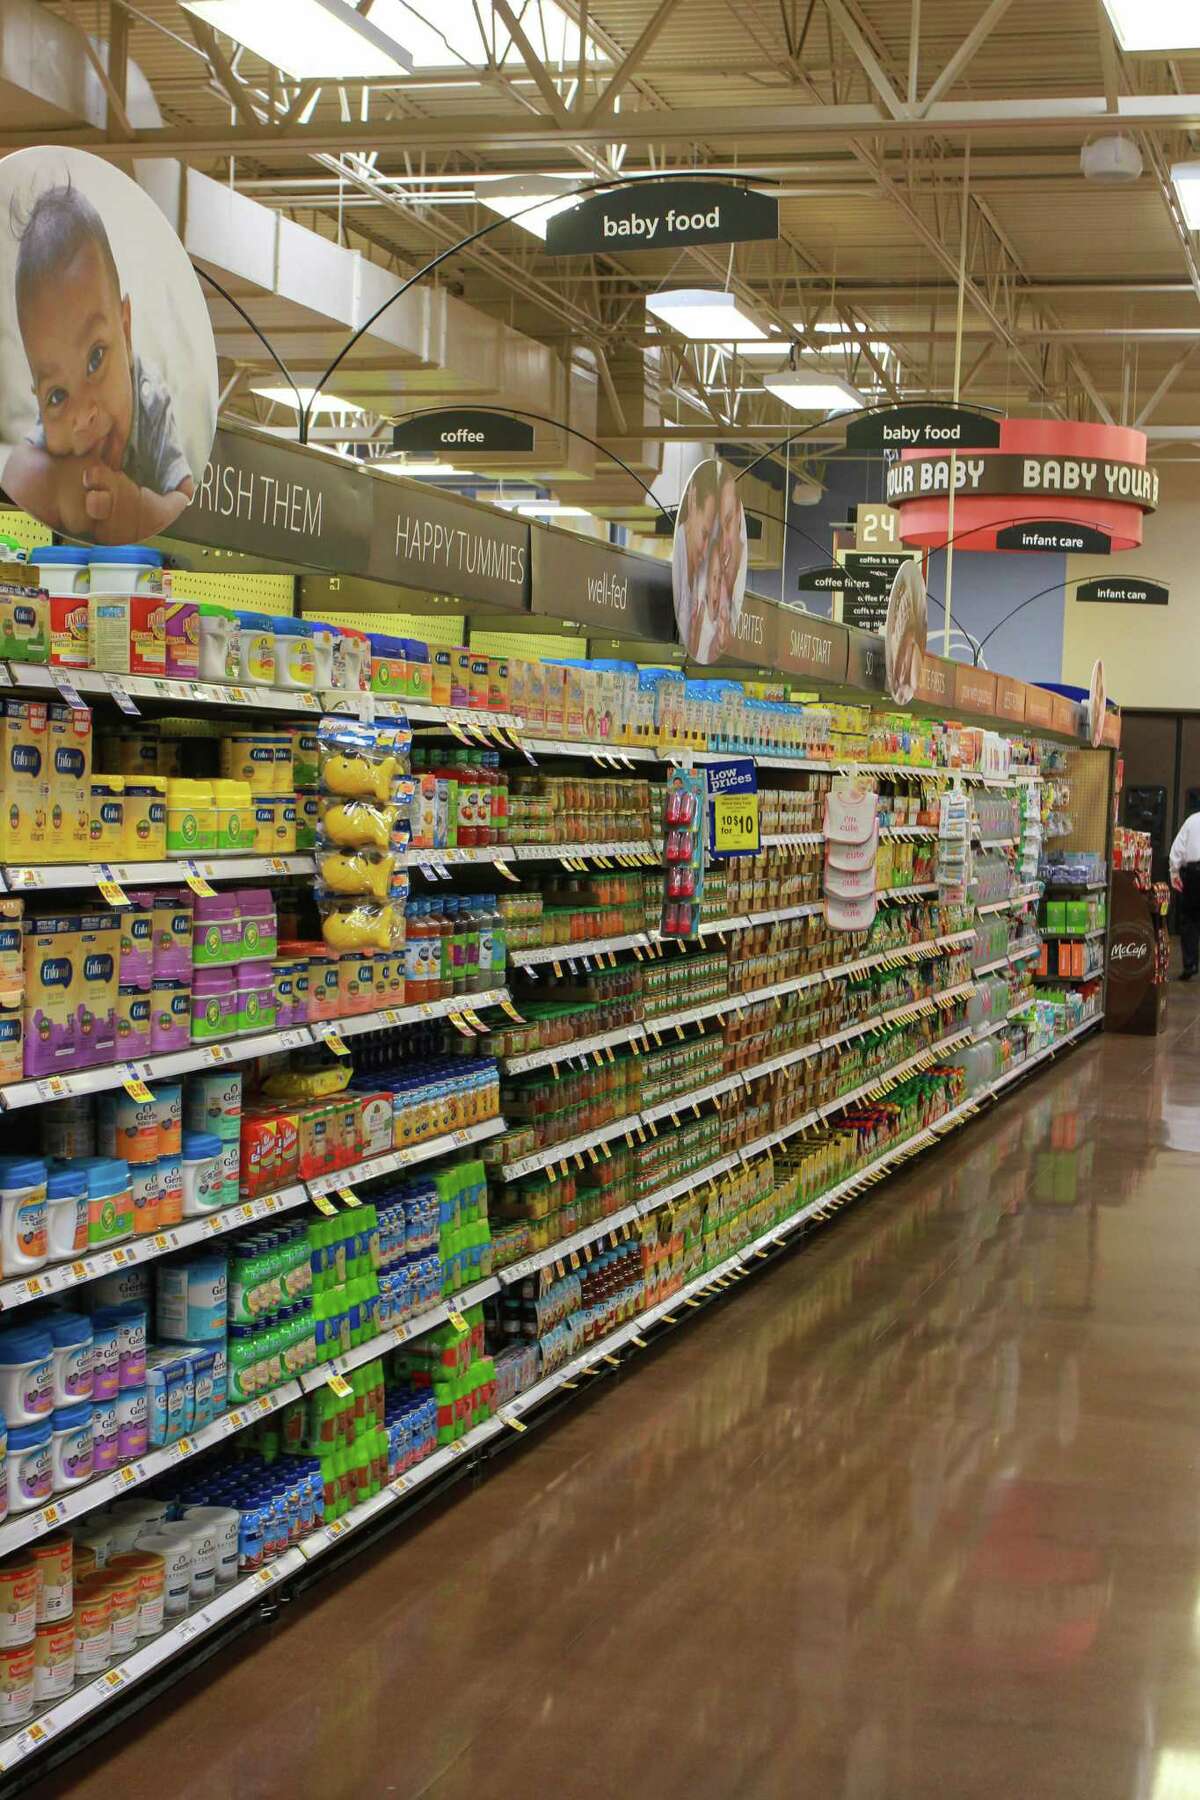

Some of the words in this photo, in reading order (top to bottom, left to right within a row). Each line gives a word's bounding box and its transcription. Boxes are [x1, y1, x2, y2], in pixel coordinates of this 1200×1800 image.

[604, 213, 659, 238] baby
[665, 206, 720, 232] food
[440, 428, 485, 443] coffee
[883, 424, 919, 443] baby
[923, 424, 961, 440] food
[920, 460, 985, 491] BABY
[1023, 460, 1097, 491] BABY
[1104, 463, 1151, 499] YOUR
[188, 462, 253, 521] RISH
[260, 476, 323, 537] THEM
[863, 513, 894, 542] 24
[396, 515, 455, 566] HAPPY
[457, 530, 525, 585] TUMMIES
[1022, 533, 1057, 547] infant
[1060, 538, 1083, 548] care
[814, 578, 842, 588] coffee
[844, 577, 870, 588] fiers
[587, 575, 628, 610] well-fed
[1097, 588, 1126, 600] infant
[1127, 590, 1147, 600] care
[811, 636, 833, 665] START
[708, 767, 737, 781] Low
[711, 774, 752, 792] prices
[722, 815, 733, 826] 10
[721, 827, 732, 835] for
